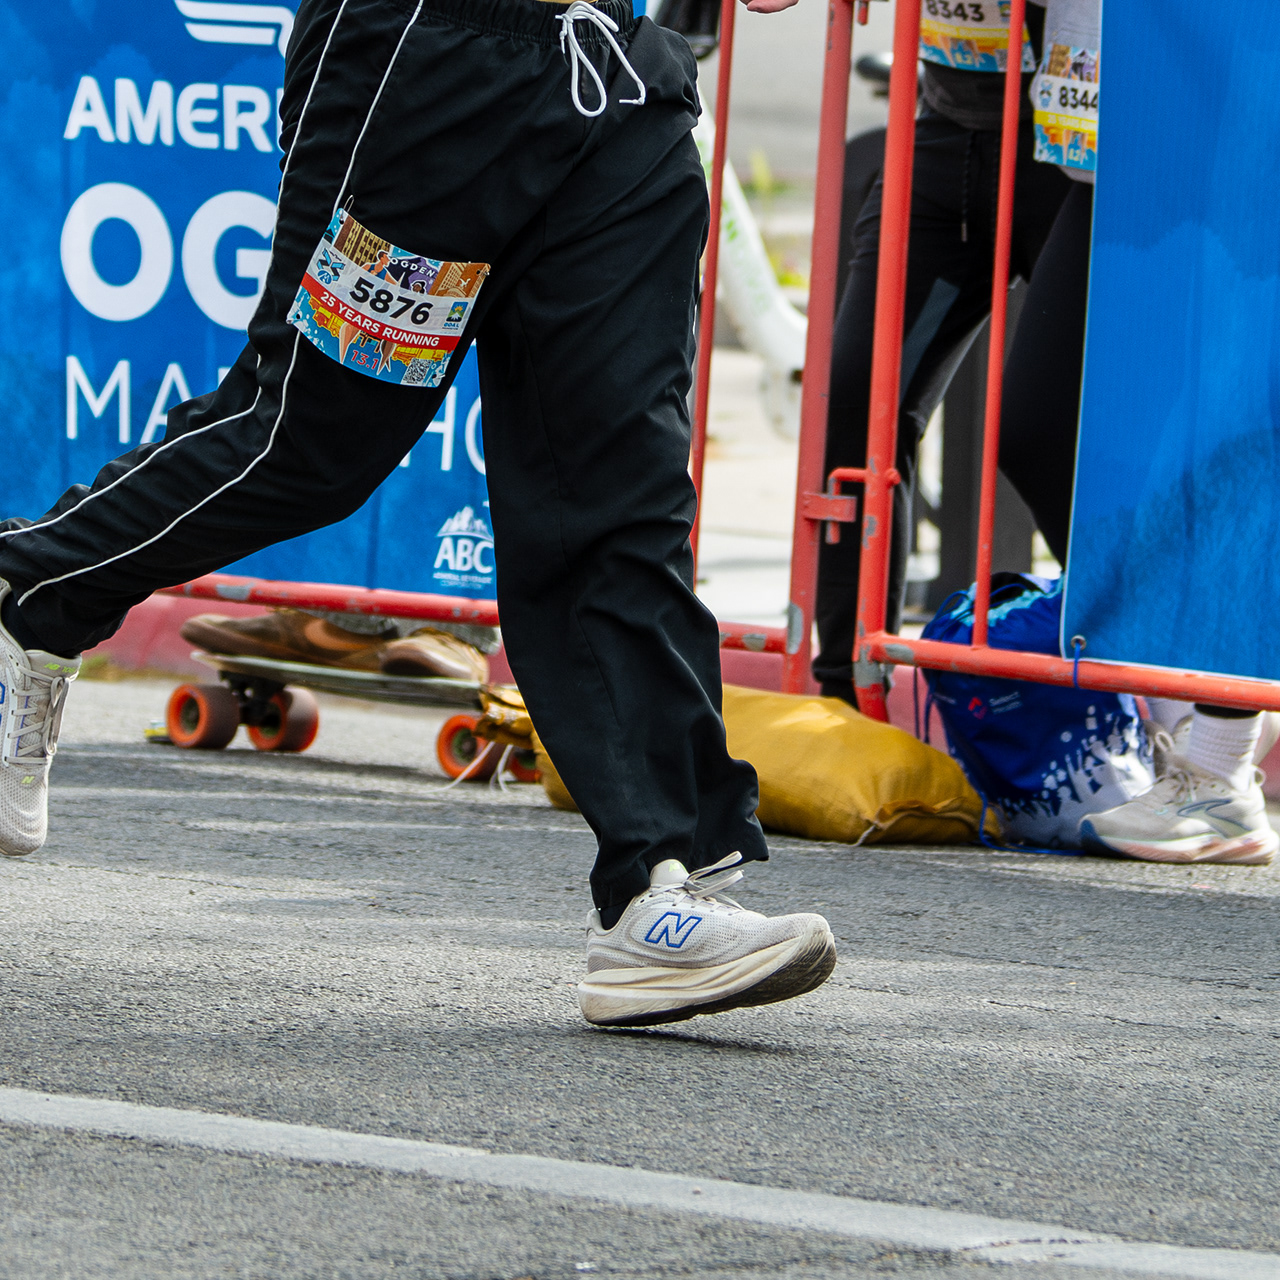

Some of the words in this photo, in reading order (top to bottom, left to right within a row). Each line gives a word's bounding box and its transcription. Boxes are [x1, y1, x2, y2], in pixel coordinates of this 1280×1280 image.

[391, 256, 436, 278] OGDEN
[320, 291, 336, 307] 25
[336, 303, 380, 333] YEARS
[382, 328, 440, 347] RUNNING
[349, 276, 434, 326] 5876
[350, 349, 380, 370] 13.1
[433, 536, 494, 574] ABC
